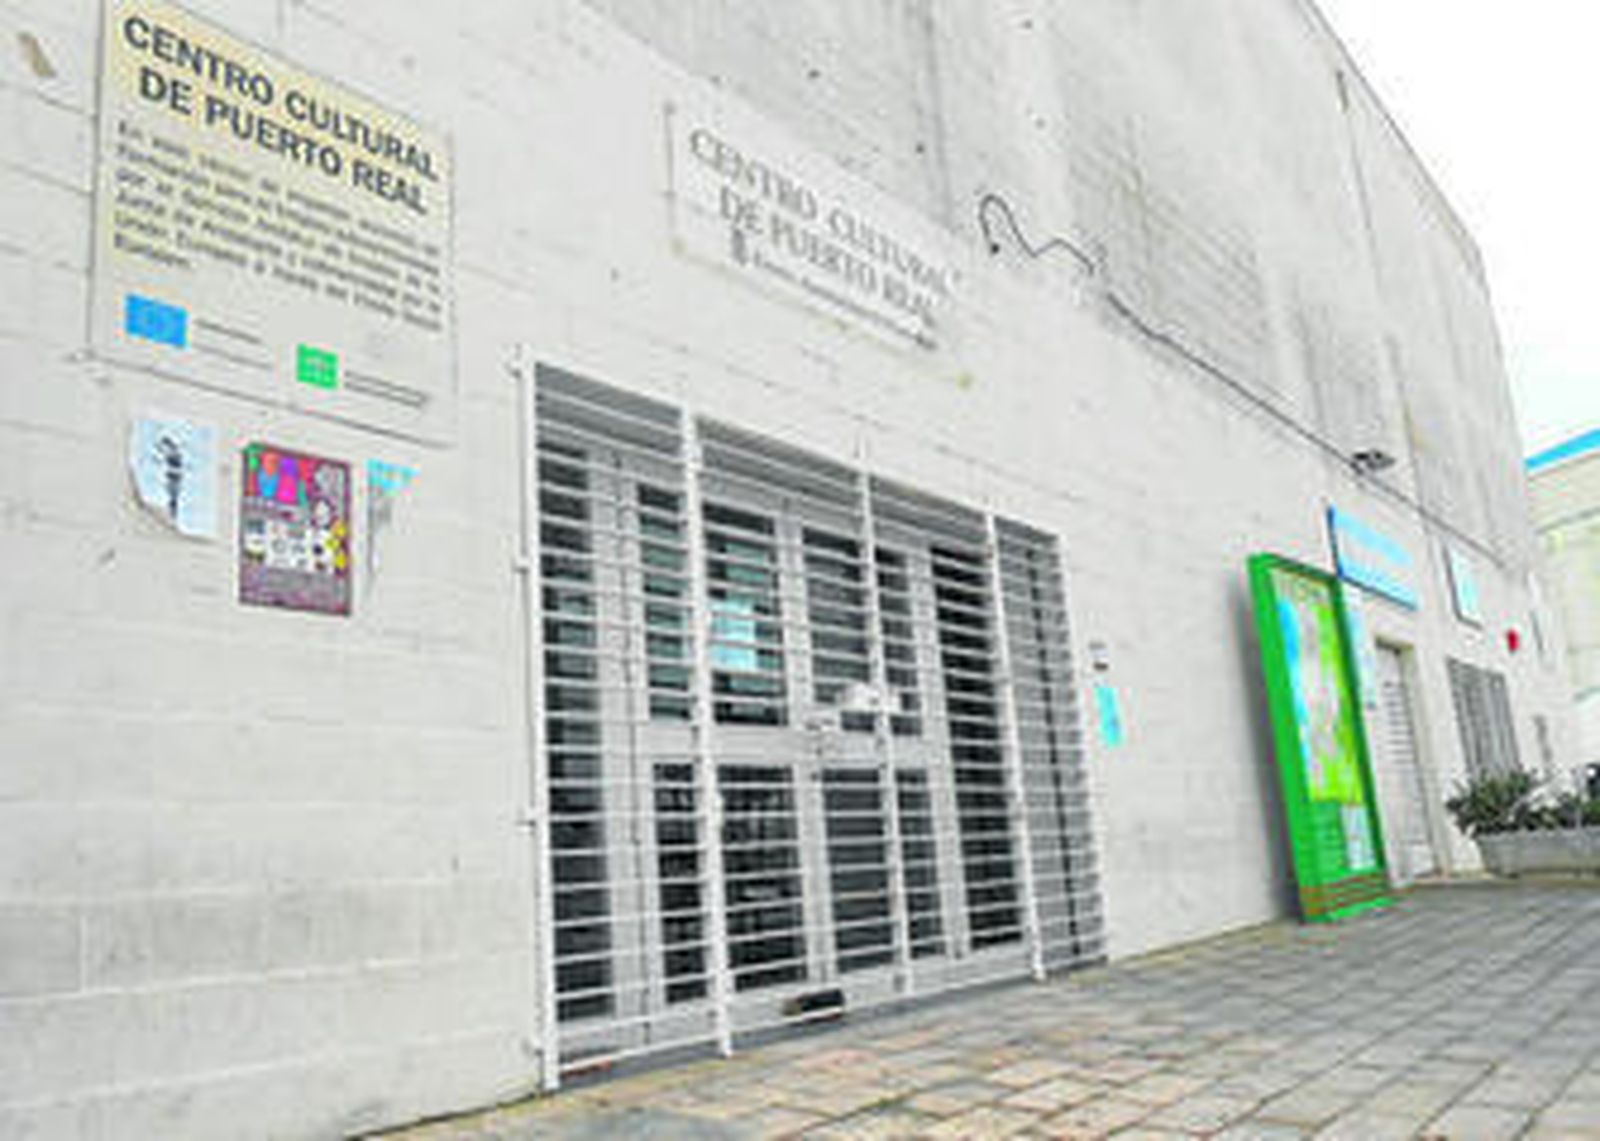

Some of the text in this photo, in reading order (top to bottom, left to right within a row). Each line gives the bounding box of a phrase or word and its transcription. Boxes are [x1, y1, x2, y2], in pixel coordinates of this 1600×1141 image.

[123, 16, 438, 182] CENTRO CULTURAL
[140, 66, 192, 115] DE
[205, 95, 342, 176] PUERTO
[352, 160, 428, 216] REAL
[689, 129, 957, 297] CENTRO CULTURAL
[720, 186, 764, 236] DE
[771, 212, 877, 292] PUERTO
